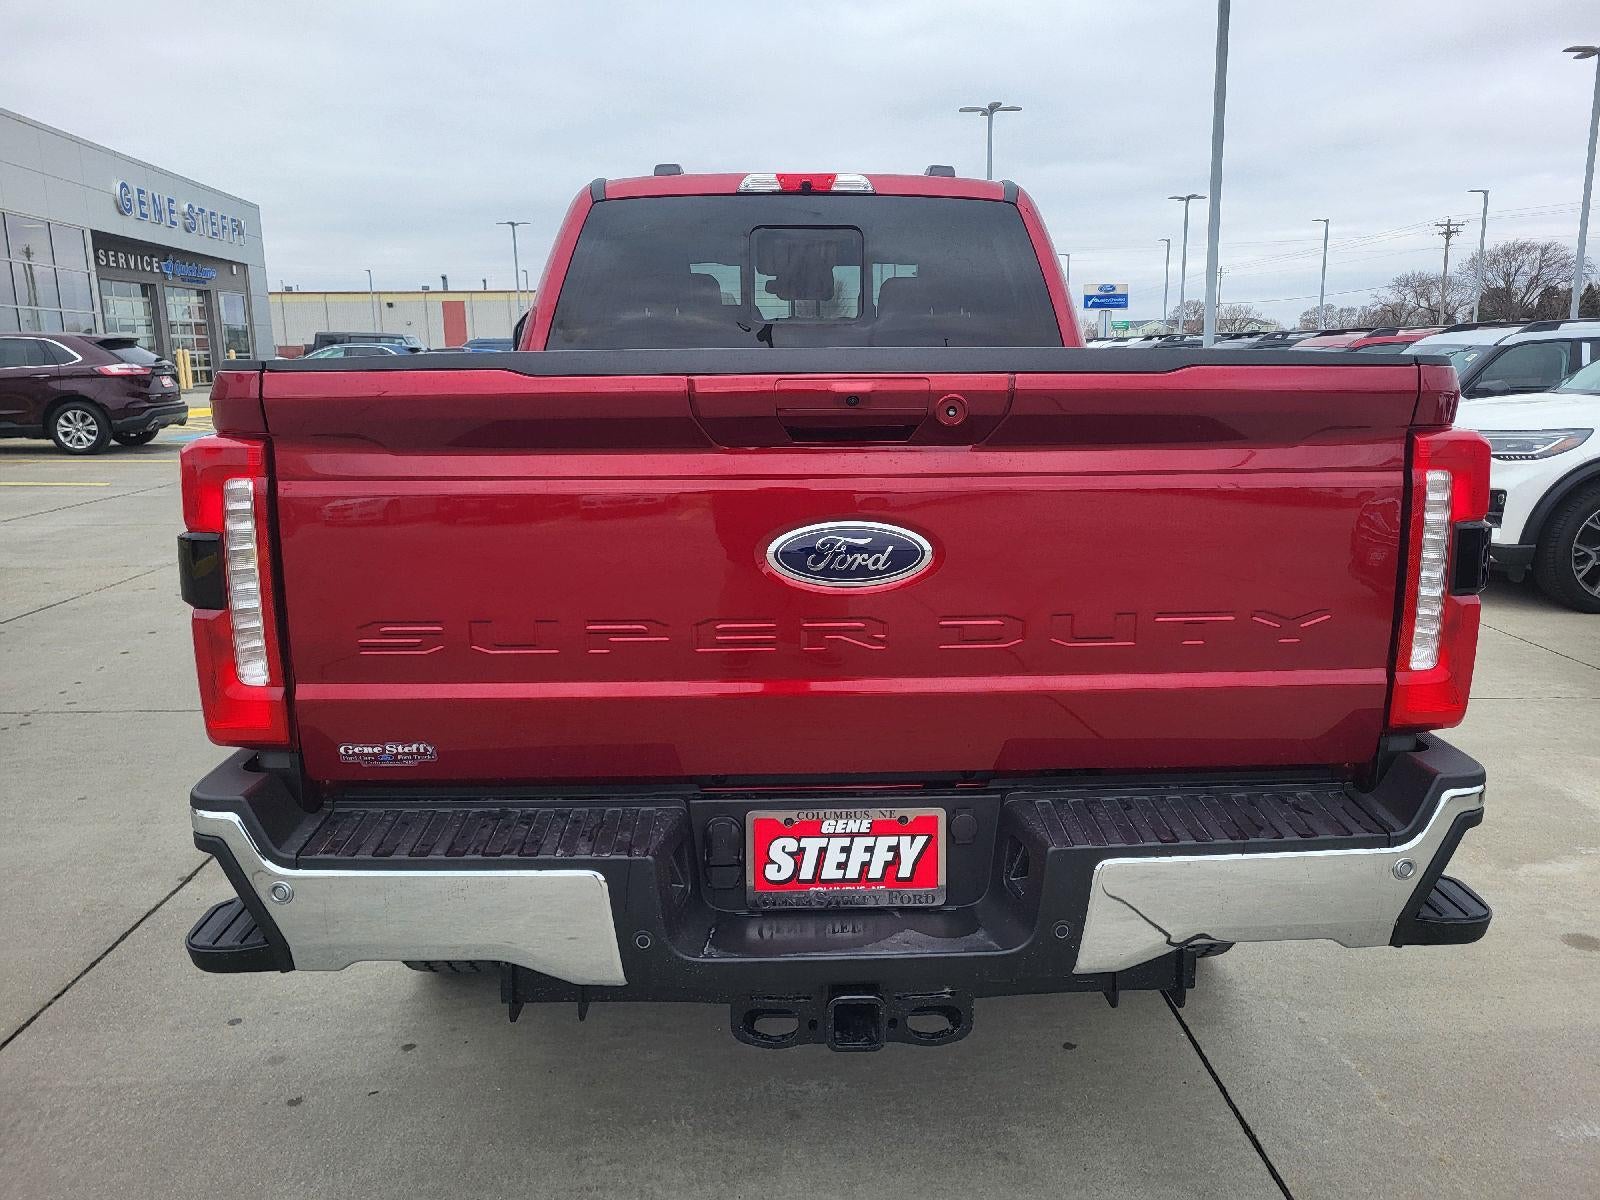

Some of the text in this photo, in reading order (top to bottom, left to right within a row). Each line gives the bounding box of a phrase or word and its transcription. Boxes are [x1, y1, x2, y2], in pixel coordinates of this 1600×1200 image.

[116, 180, 246, 246] GENE STEFFY
[98, 248, 160, 273] SERVICE
[806, 535, 894, 572] Ford
[356, 608, 1333, 656] SUPER DUTY
[339, 743, 435, 755] Gene Steffy
[821, 819, 873, 834] GENE
[879, 810, 897, 819] NE
[764, 835, 932, 884] STEFFY
